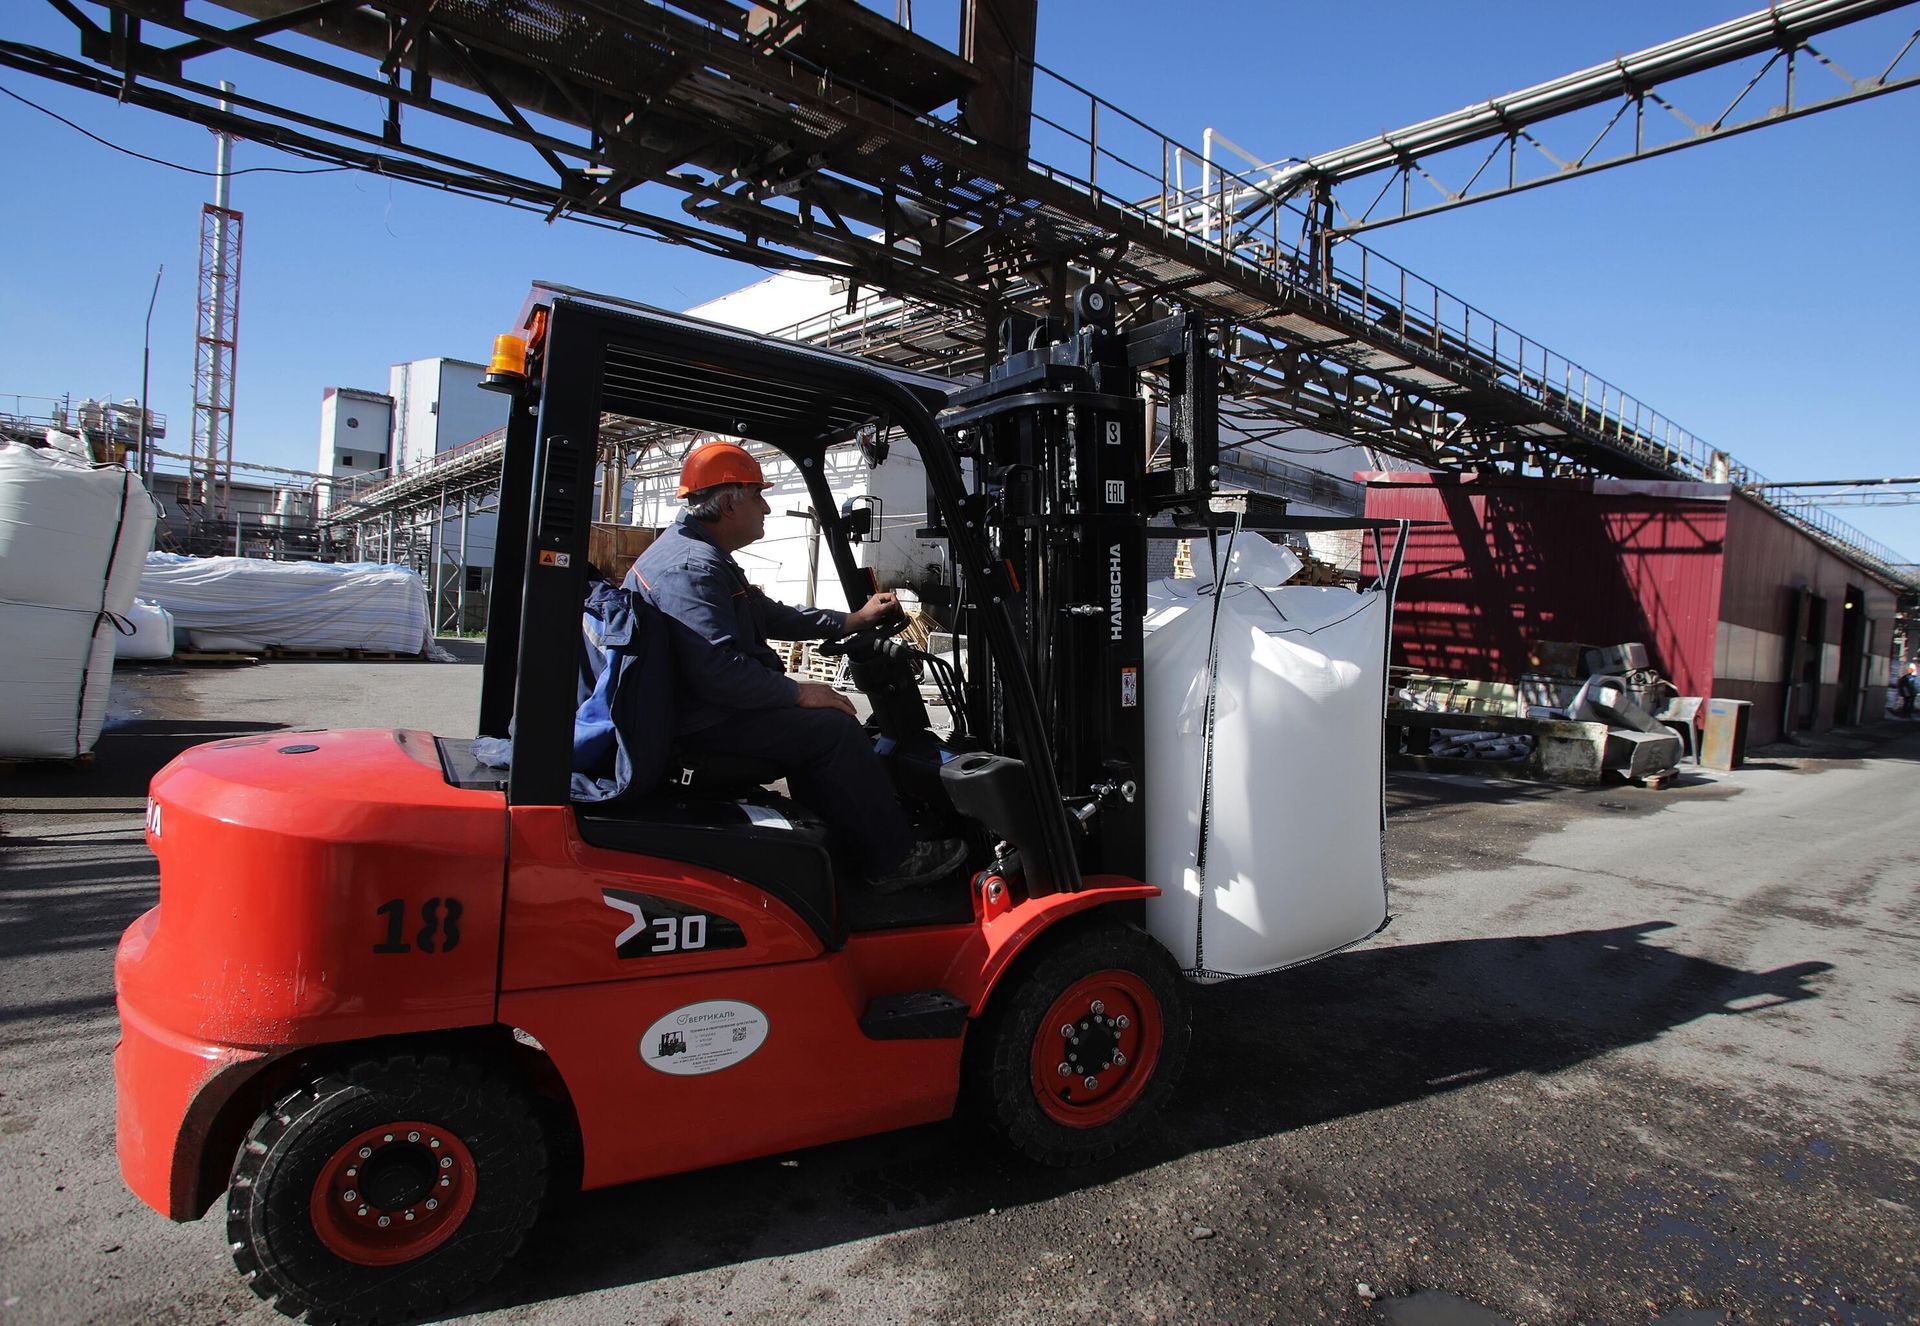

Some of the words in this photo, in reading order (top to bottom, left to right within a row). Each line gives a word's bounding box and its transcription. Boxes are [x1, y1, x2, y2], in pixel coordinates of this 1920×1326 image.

[1110, 543, 1122, 640] HANGCHA
[372, 897, 463, 954] 18
[651, 914, 707, 953] 30
[688, 1011, 736, 1024] ВЕРТИКАЛЬ
